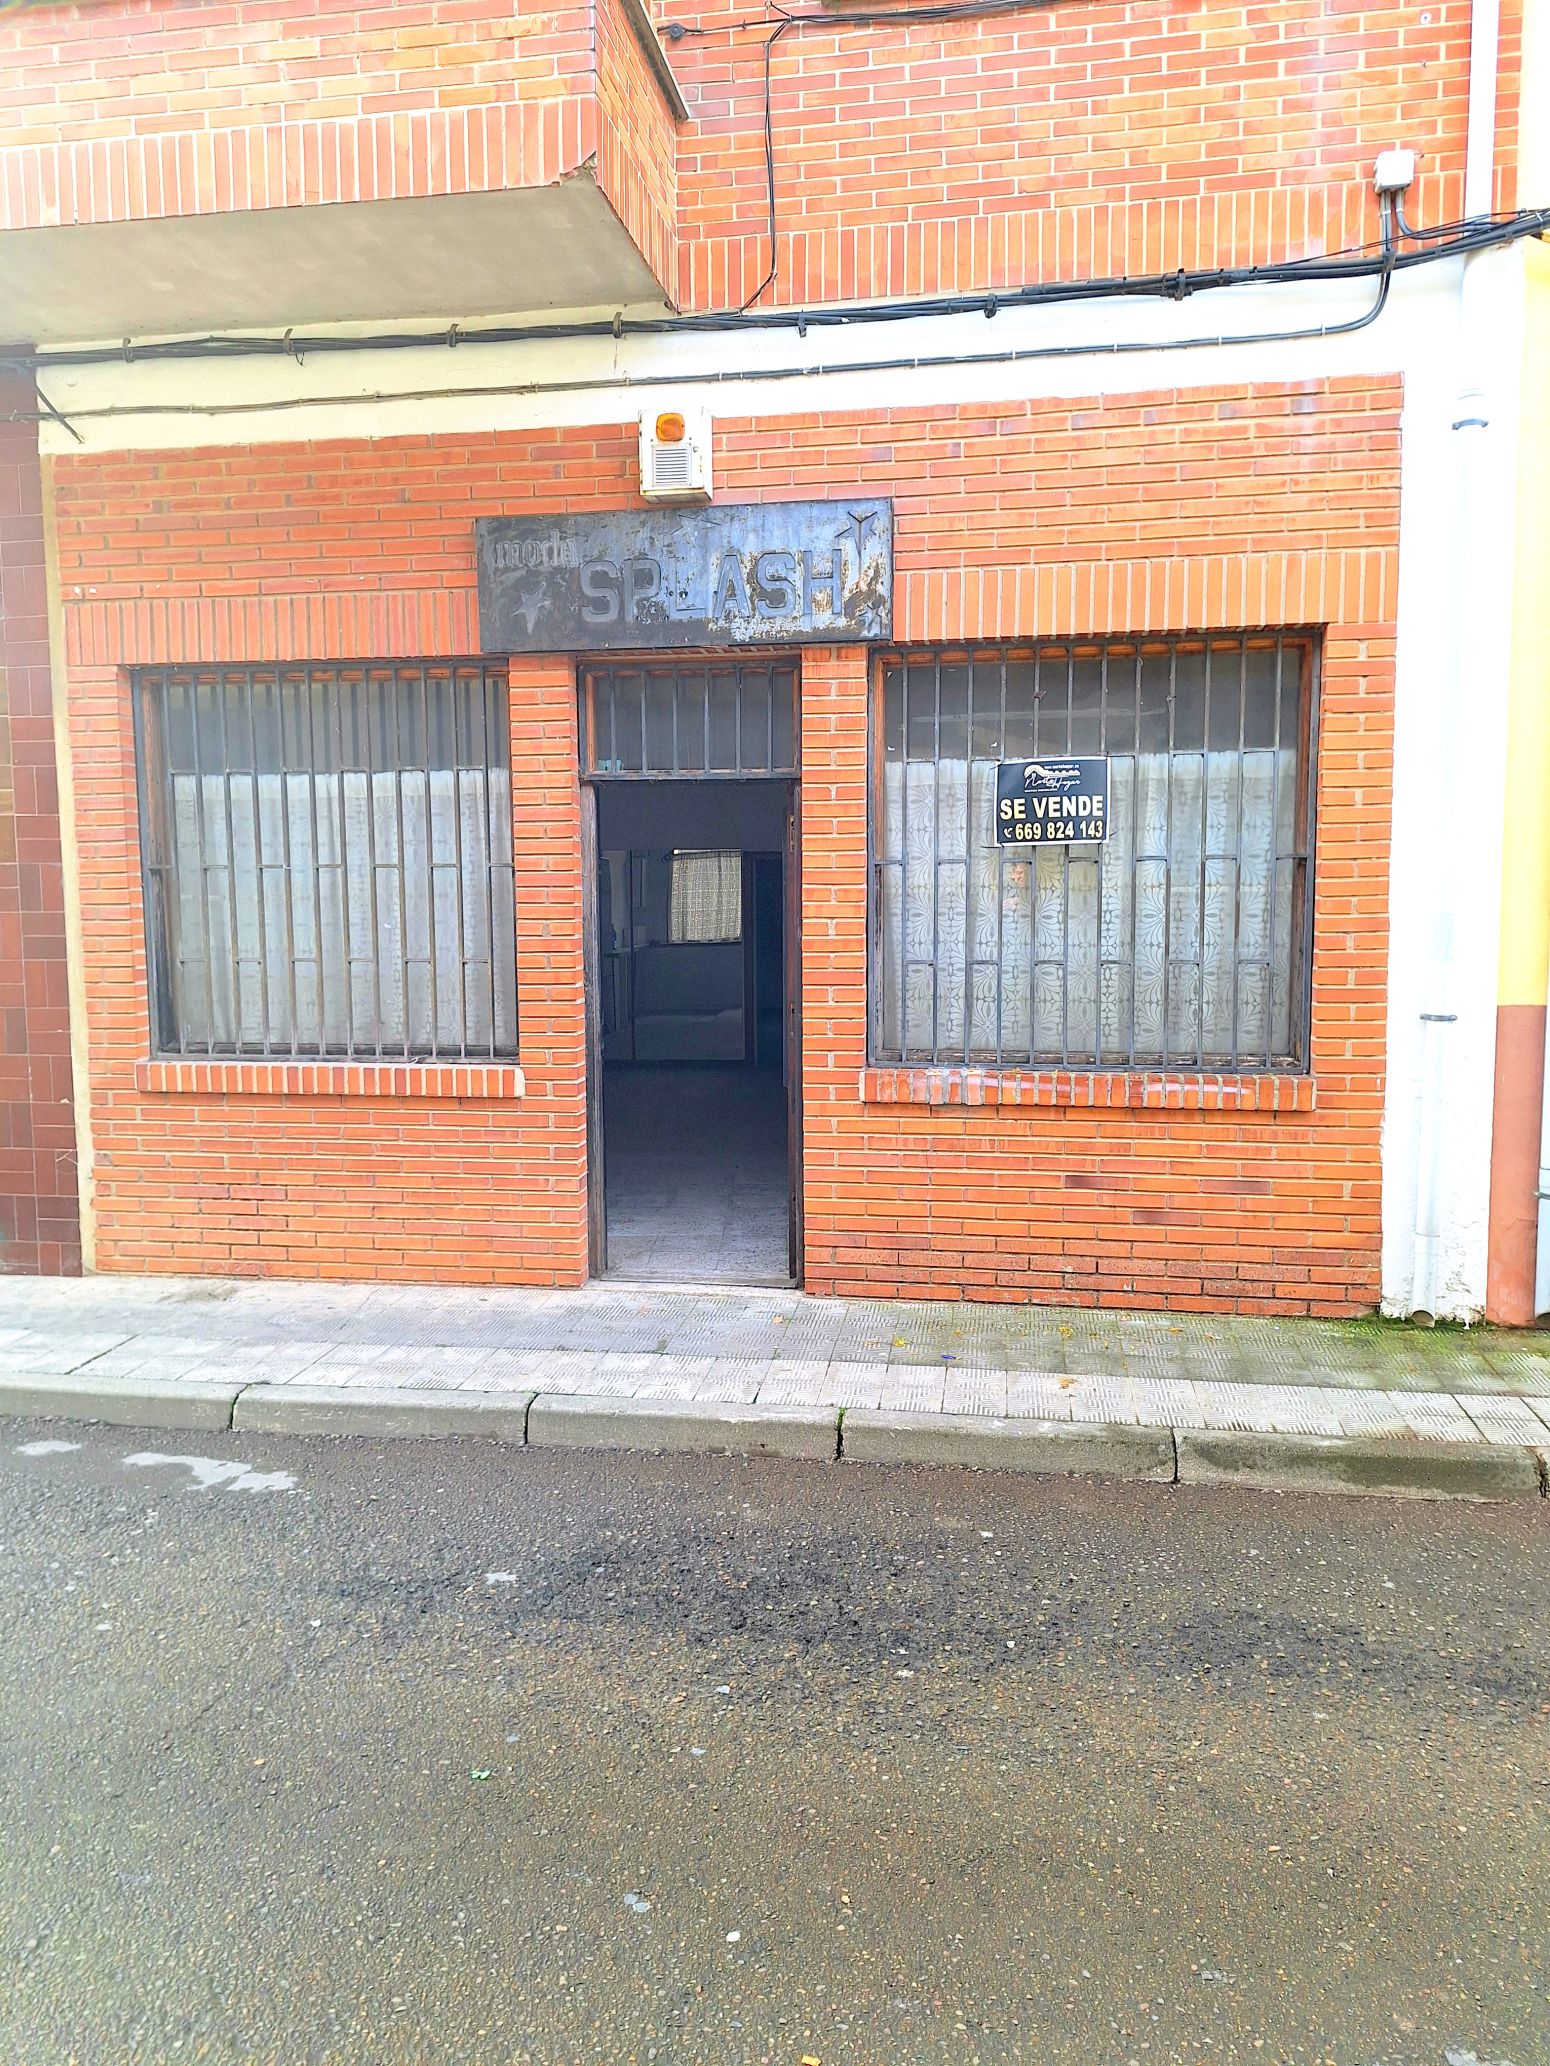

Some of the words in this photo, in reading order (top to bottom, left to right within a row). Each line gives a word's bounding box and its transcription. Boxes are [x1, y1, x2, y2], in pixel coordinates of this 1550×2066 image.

[493, 528, 578, 568] moda
[580, 547, 843, 624] SPLASH
[1000, 799, 1026, 820] SE
[1032, 796, 1104, 818] VENDE
[1015, 823, 1042, 840] 669
[1046, 821, 1074, 839] 824
[1080, 820, 1103, 838] 143
